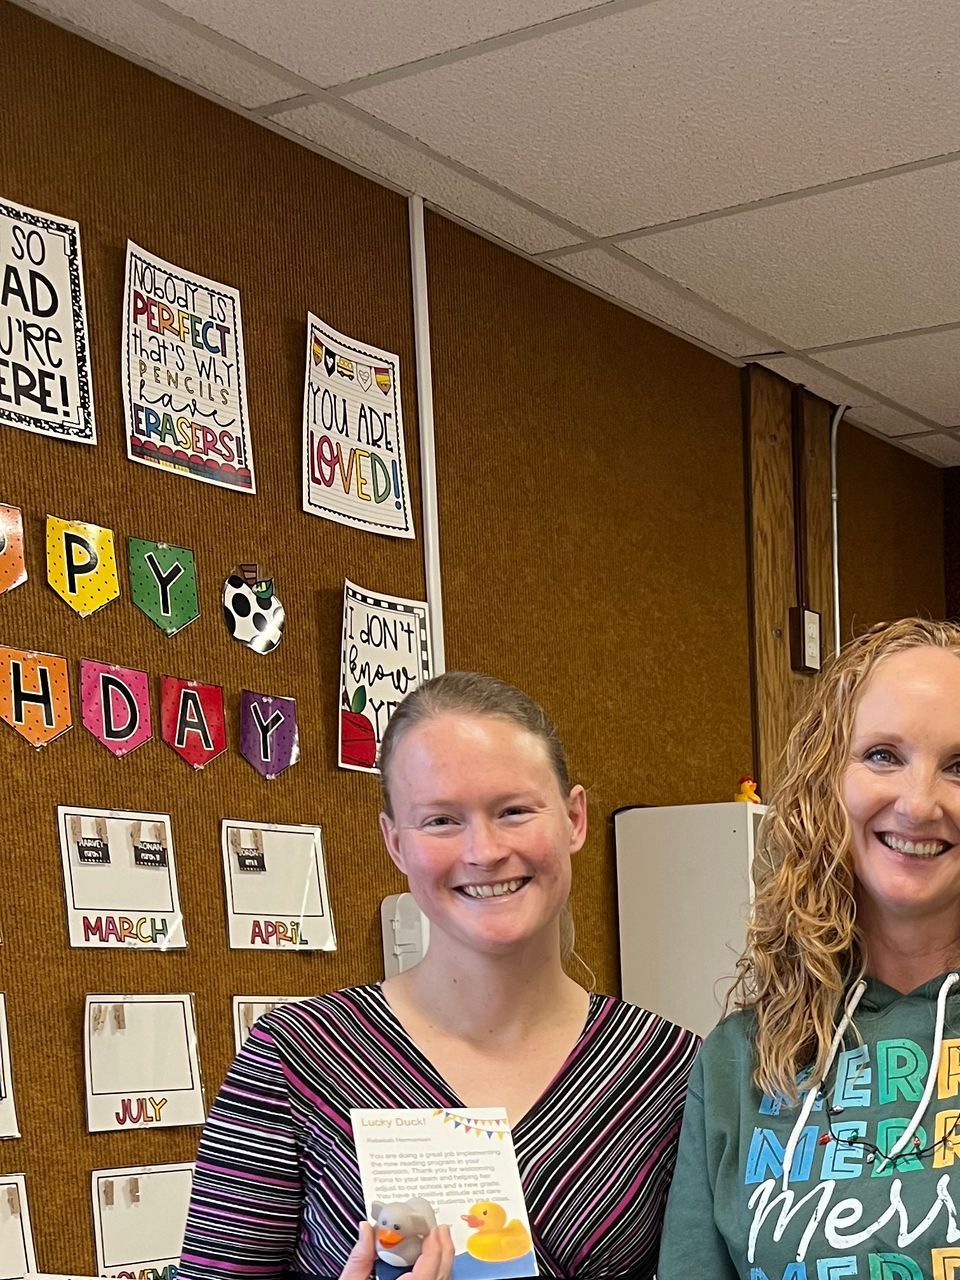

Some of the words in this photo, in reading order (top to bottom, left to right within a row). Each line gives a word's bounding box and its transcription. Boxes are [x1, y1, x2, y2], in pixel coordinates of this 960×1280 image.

[12, 225, 46, 266] SO
[133, 288, 231, 358] PERFECT
[207, 291, 228, 323] IS
[138, 358, 230, 406] PENCILS
[139, 378, 236, 427] have
[133, 402, 244, 466] ERASERS!
[310, 383, 350, 438] YOU
[357, 402, 394, 453] ARE
[309, 429, 403, 510] LOVED!
[349, 644, 417, 694] know
[82, 915, 169, 943] MARCH
[114, 1097, 168, 1126] JULY
[361, 1117, 392, 1129] Lucky
[395, 1117, 426, 1127] Duck!
